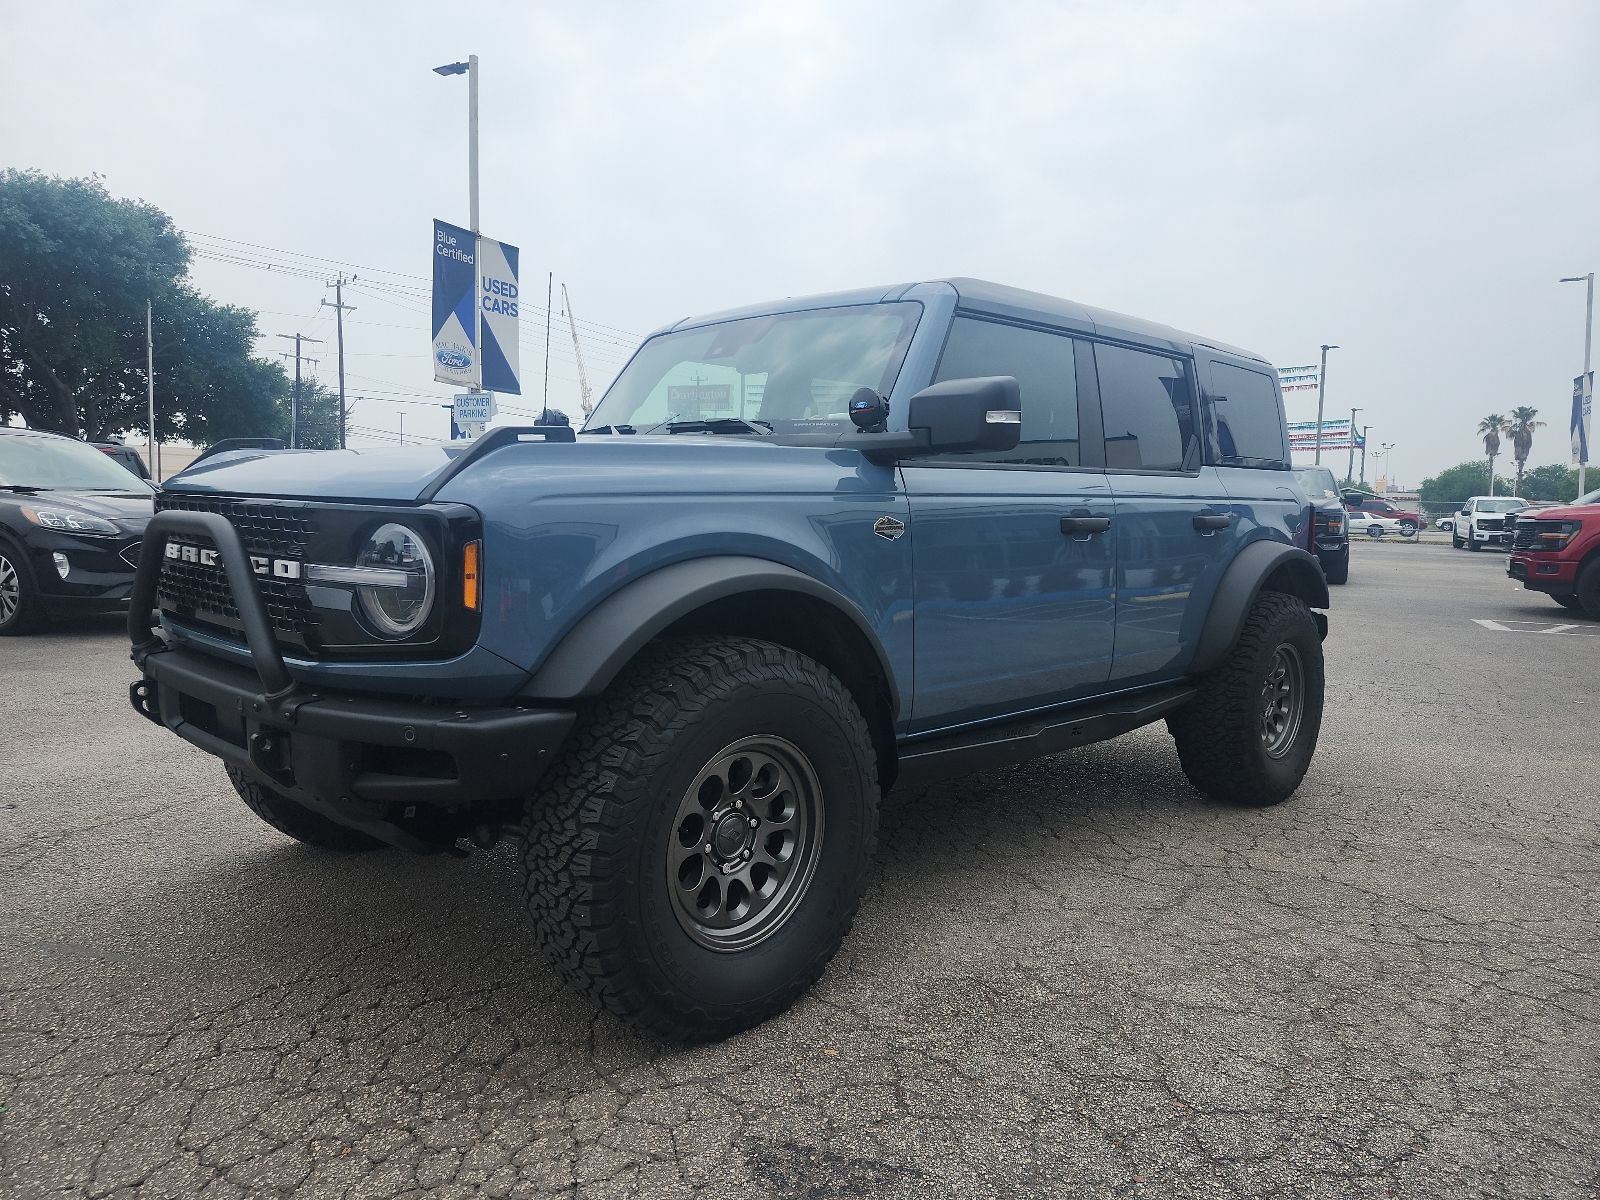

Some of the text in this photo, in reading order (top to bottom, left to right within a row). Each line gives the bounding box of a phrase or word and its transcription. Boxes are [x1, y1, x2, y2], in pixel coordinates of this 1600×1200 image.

[437, 229, 457, 246] Blue
[436, 243, 474, 265] Certified
[482, 275, 518, 299] USED
[482, 295, 519, 317] CARS
[441, 351, 465, 367] Ford
[456, 397, 490, 407] CUSTOMER
[459, 409, 487, 418] PARKING
[165, 543, 300, 579] BROCO
